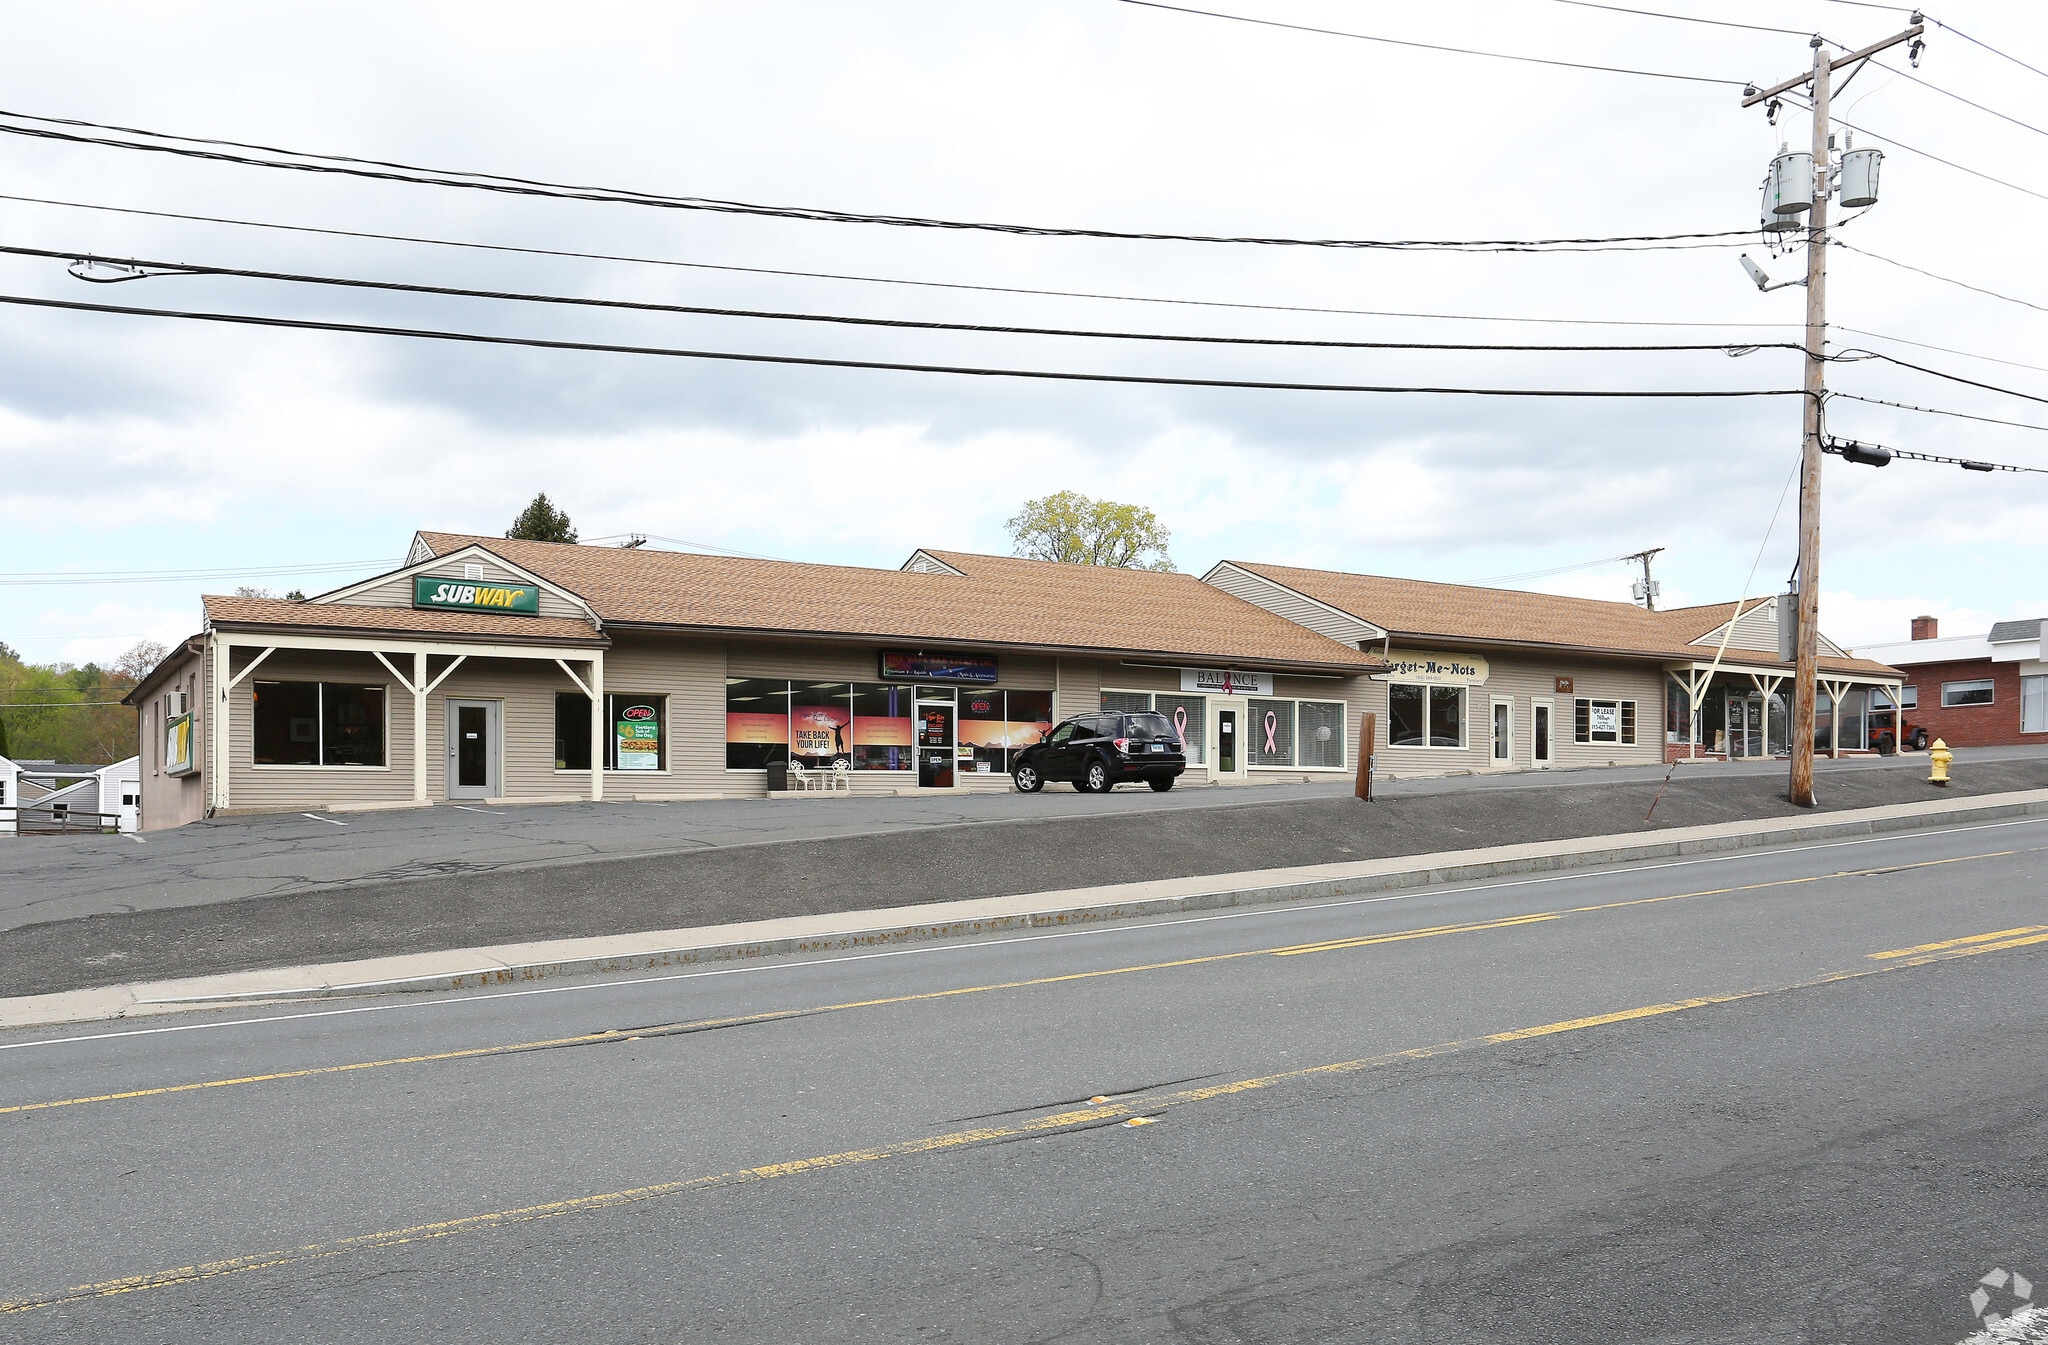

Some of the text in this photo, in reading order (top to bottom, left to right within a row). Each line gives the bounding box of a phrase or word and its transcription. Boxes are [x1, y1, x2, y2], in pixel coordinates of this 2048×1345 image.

[430, 584, 525, 607] SUBWAY
[930, 656, 947, 664] BAR
[1197, 671, 1258, 686] BALNCE
[971, 702, 990, 710] OPEN
[626, 709, 652, 718] OPEN
[620, 725, 634, 737] $6
[796, 731, 830, 739] TAKE BACK
[797, 740, 830, 748] YOUR LIFE!
